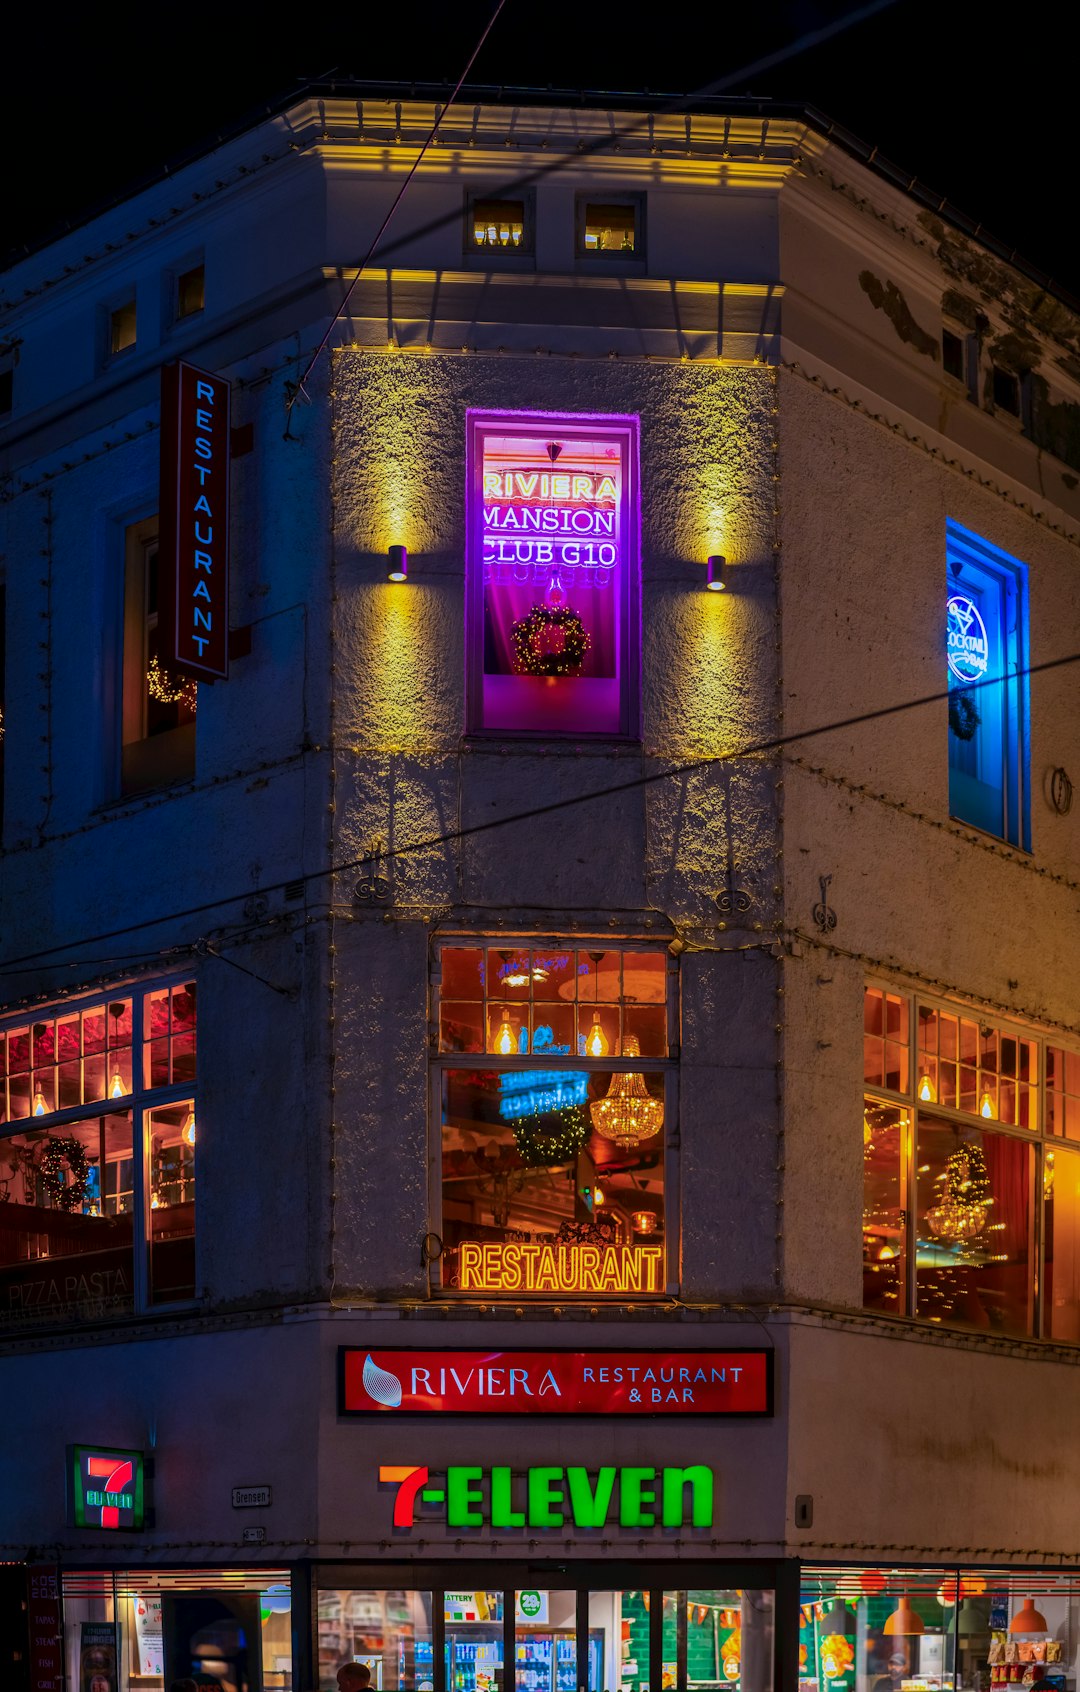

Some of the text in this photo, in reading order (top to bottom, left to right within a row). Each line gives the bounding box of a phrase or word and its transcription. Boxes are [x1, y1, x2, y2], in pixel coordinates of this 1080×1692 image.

[484, 472, 618, 499] RIVIERA
[191, 380, 215, 657] RESTAURANT
[484, 507, 614, 533] MANSION
[562, 543, 616, 566] G10
[460, 1243, 662, 1291] RESTAURANT
[9, 1266, 129, 1309] PIZZA PASTA
[411, 1367, 743, 1396] RIVIERA RESTAURANT
[628, 1388, 695, 1404] & BAR
[236, 1491, 266, 1504] Grensen
[444, 1594, 473, 1602] ATTERY
[35, 1615, 55, 1625] TAPAS
[35, 1637, 56, 1647] STEAK
[38, 1658, 54, 1669] FISH
[37, 1680, 56, 1690] GRILL
